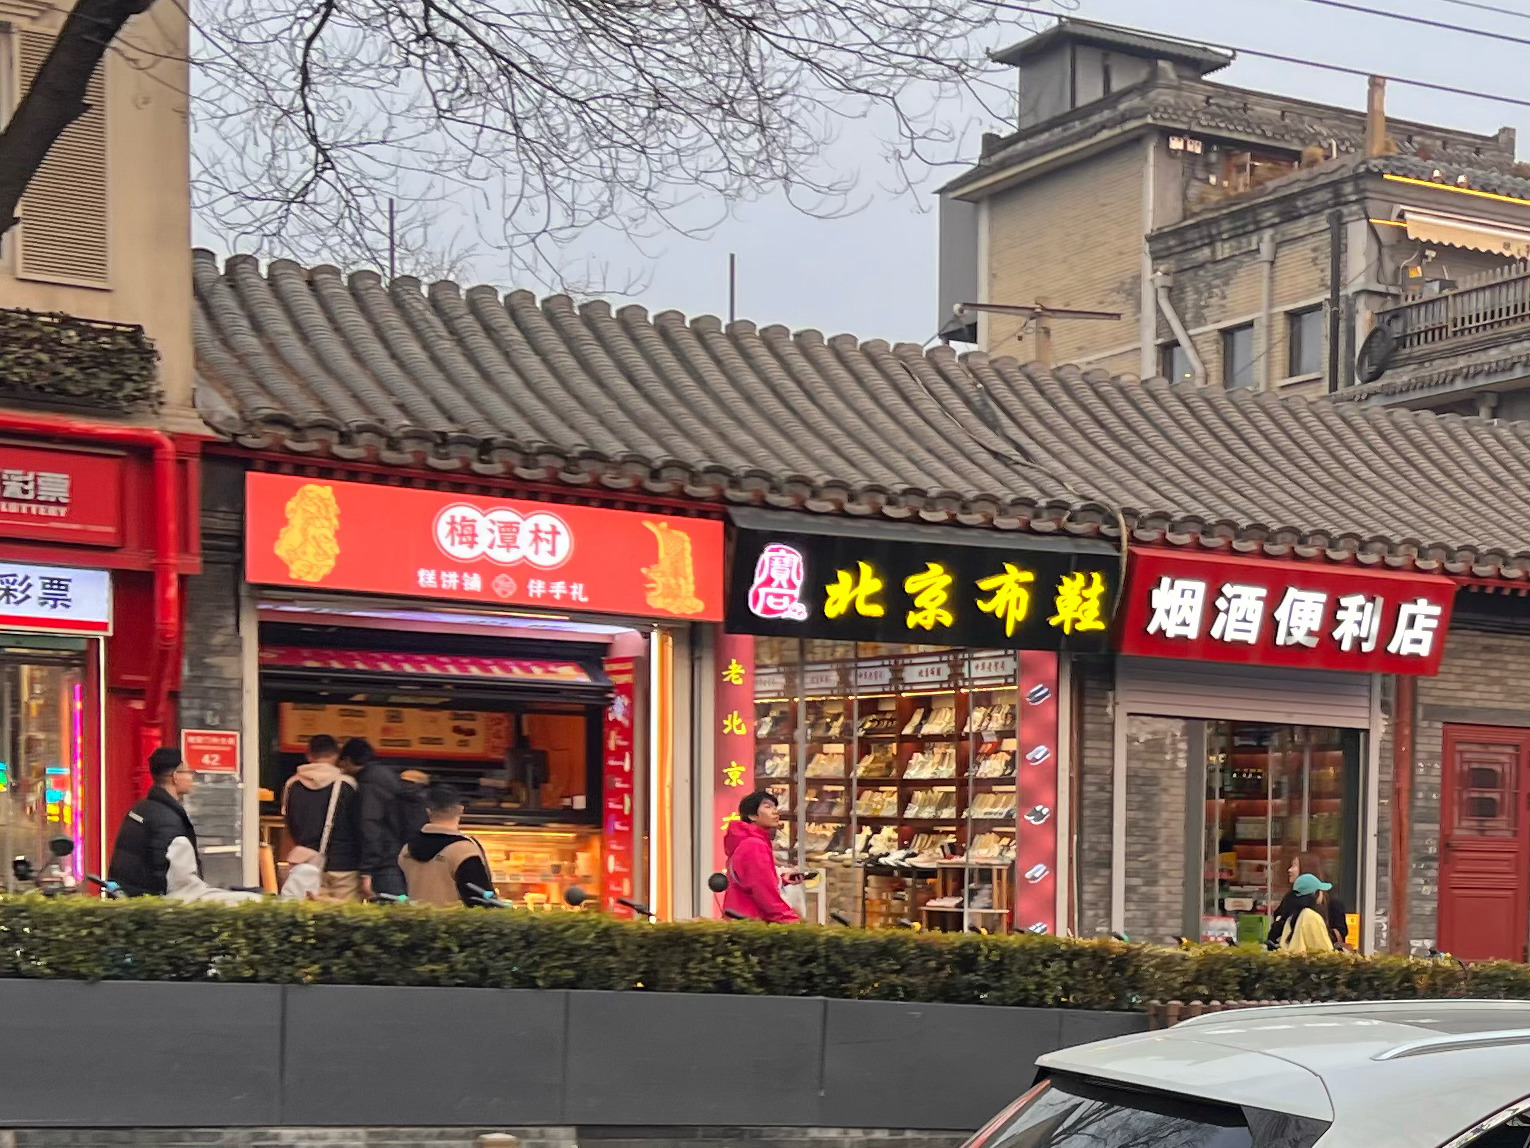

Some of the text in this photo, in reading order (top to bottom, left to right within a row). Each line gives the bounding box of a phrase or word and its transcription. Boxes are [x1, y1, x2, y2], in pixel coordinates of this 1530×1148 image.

[444, 514, 562, 558] 梅潭村
[0, 573, 73, 610] 彩票
[823, 560, 1107, 638] 北京布鞋
[1146, 575, 1443, 657] 烟酒便利店
